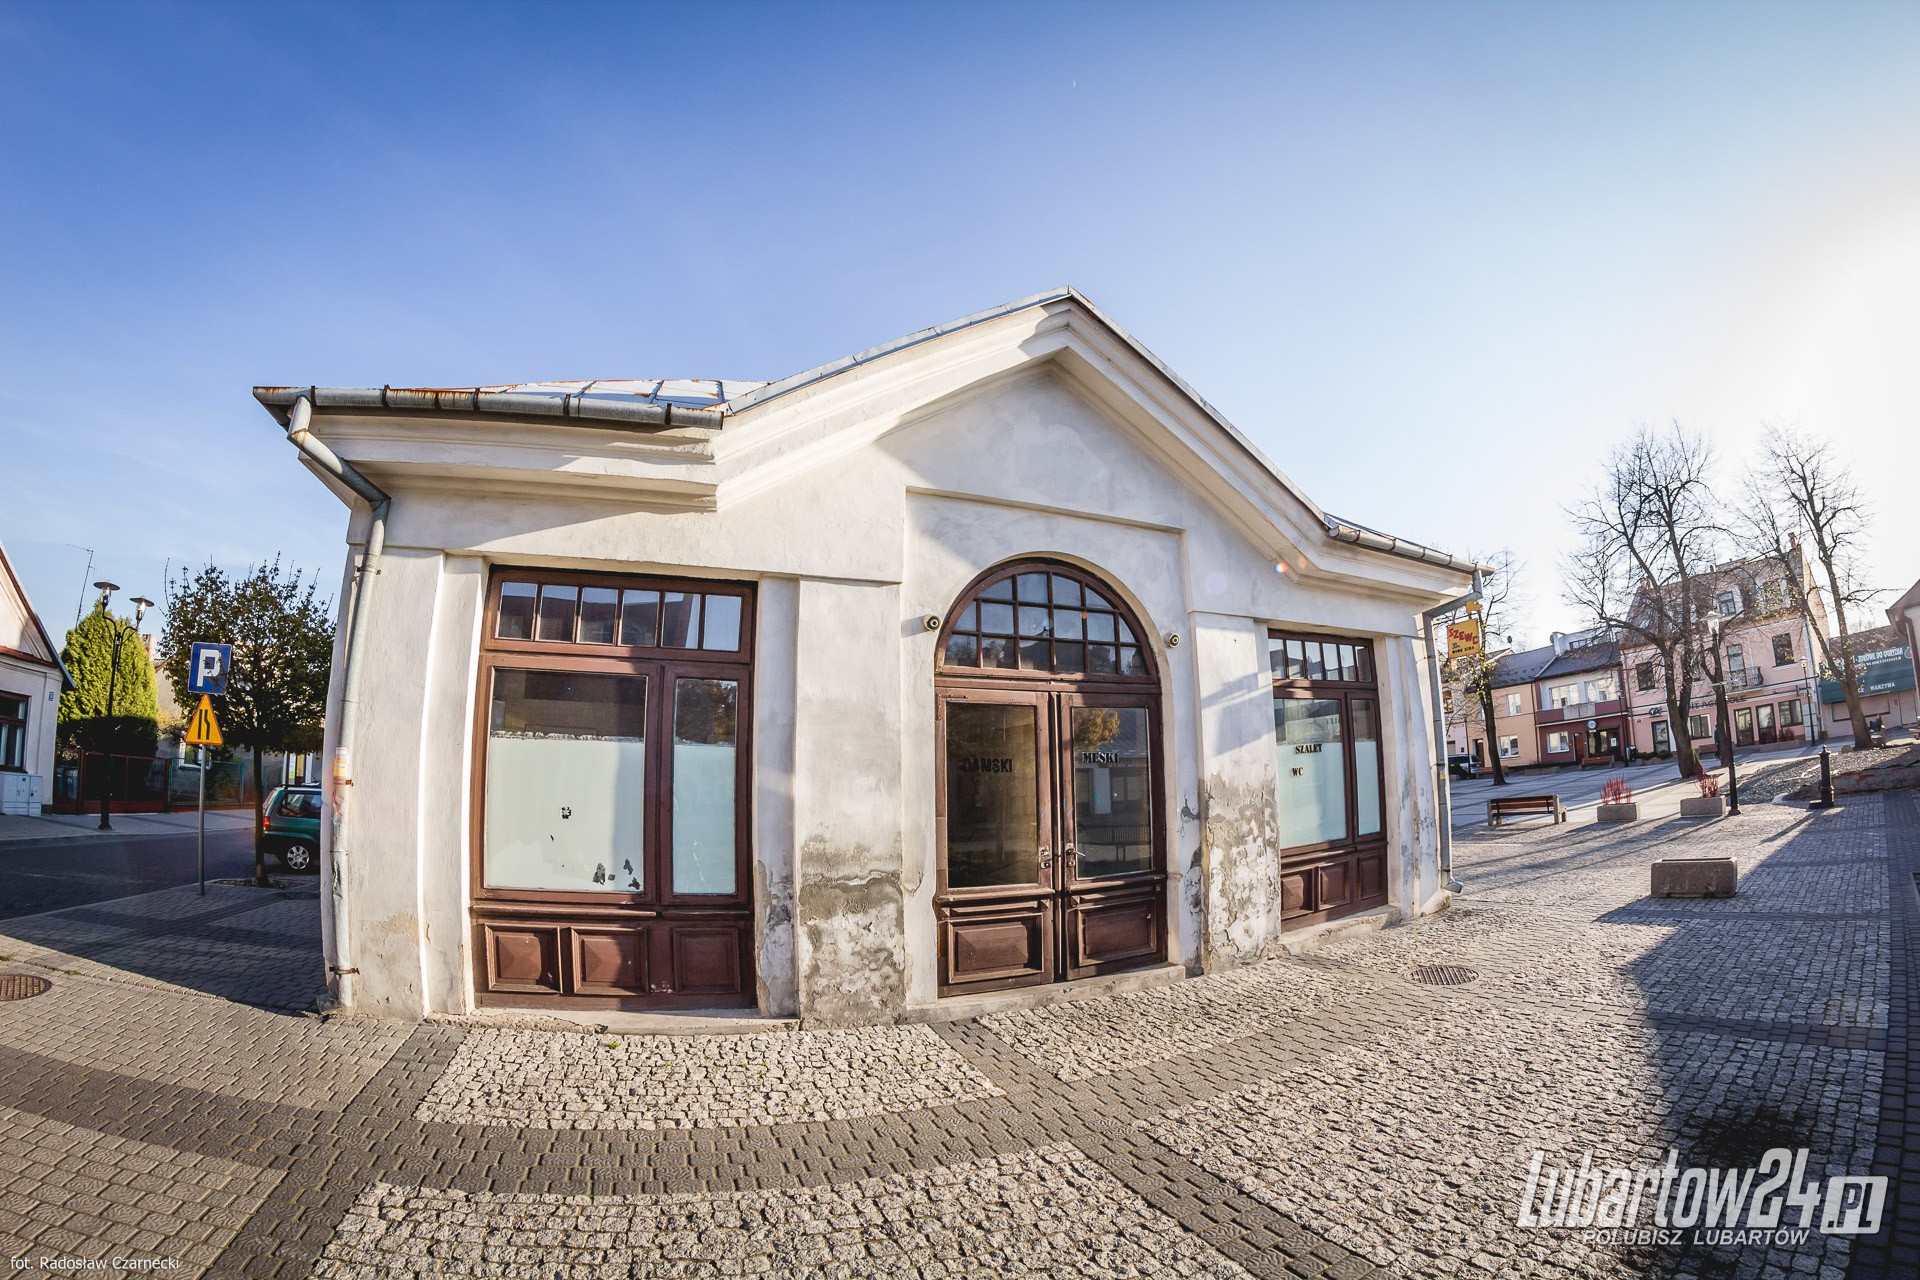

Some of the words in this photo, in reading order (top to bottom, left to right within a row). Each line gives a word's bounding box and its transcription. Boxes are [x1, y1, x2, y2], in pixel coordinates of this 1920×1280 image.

[1448, 628, 1479, 645] SZEWC
[196, 648, 221, 687] P
[1870, 682, 1895, 691] WARZYWA
[1295, 743, 1322, 754] SZALET
[1292, 767, 1304, 777] WC
